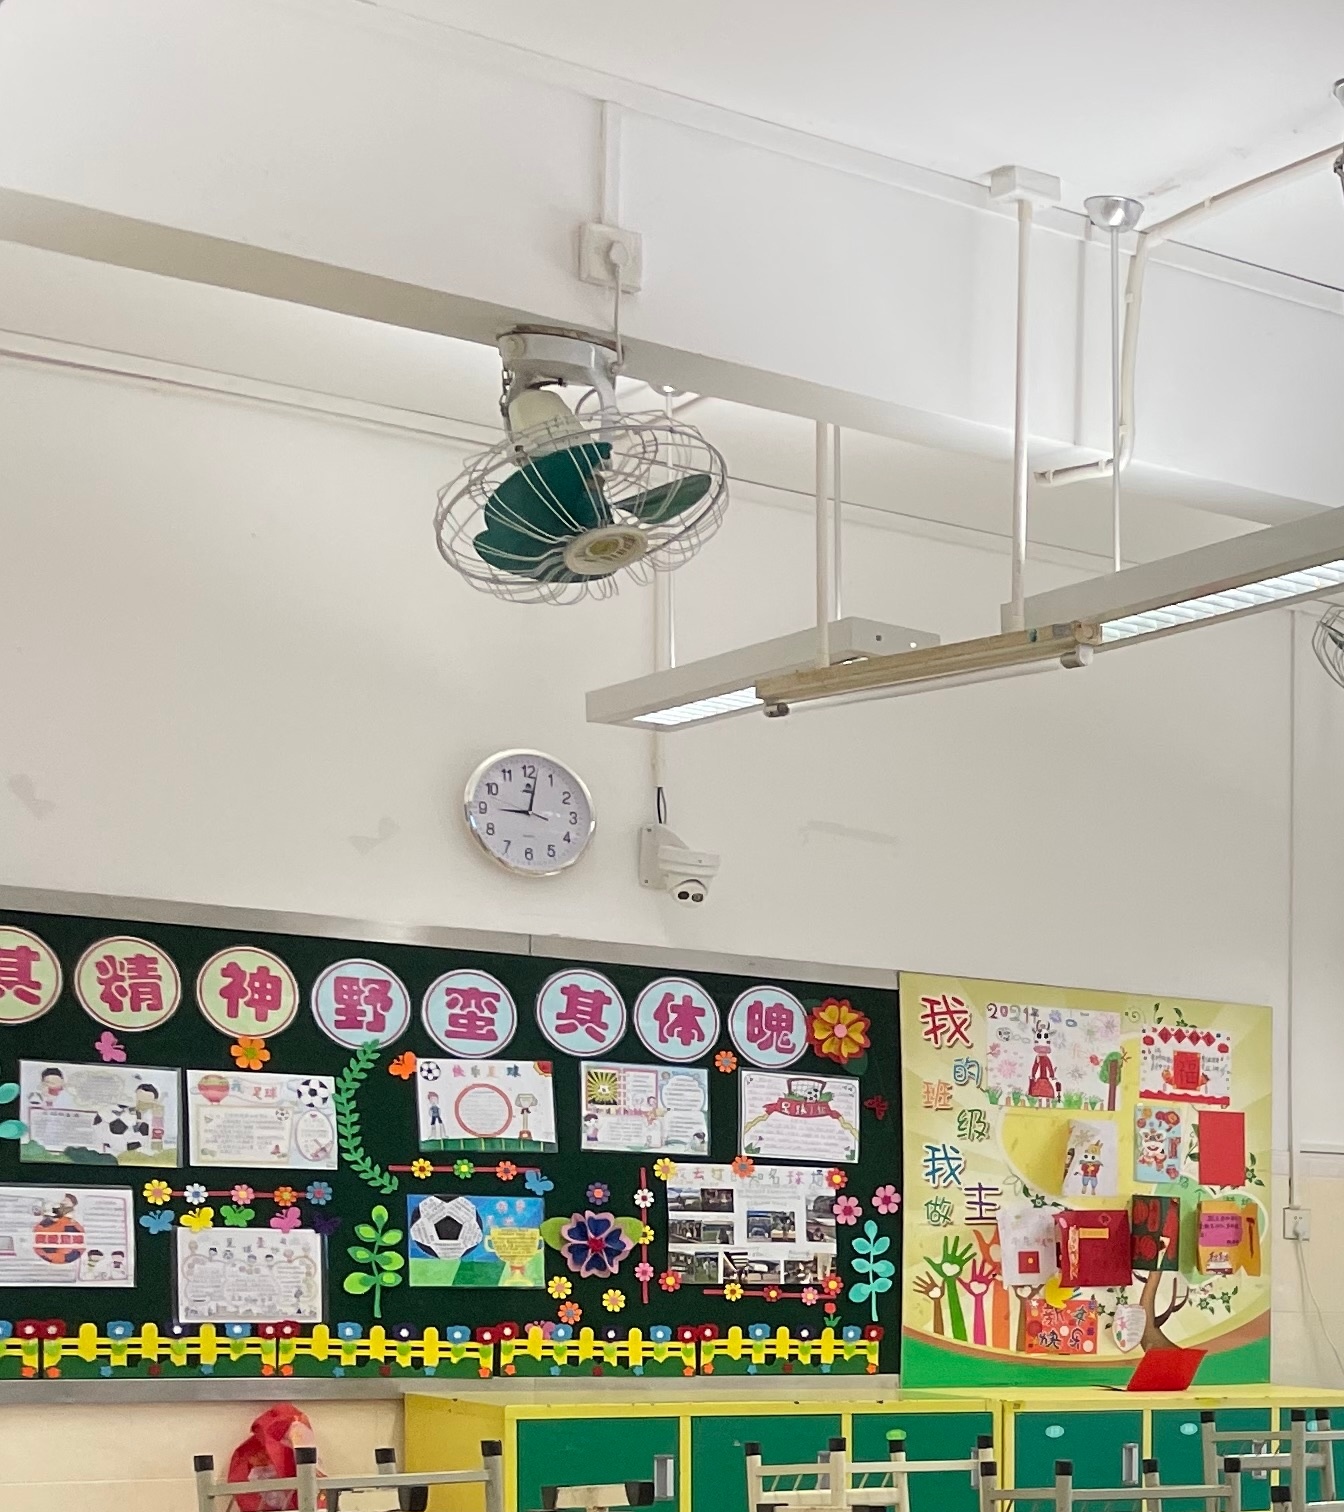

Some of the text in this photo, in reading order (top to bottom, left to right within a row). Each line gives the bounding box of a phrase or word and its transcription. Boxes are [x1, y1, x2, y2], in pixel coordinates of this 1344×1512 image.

[502, 768, 512, 783] 11
[521, 765, 536, 779] 12
[548, 774, 554, 787] 1
[486, 782, 499, 797] 10
[562, 791, 571, 805] 2
[478, 801, 488, 815] 9
[569, 811, 578, 825] 3
[486, 822, 495, 836] 8
[562, 831, 571, 844] 4
[503, 840, 511, 854] 7
[524, 847, 534, 861] 6
[547, 844, 556, 857] 5
